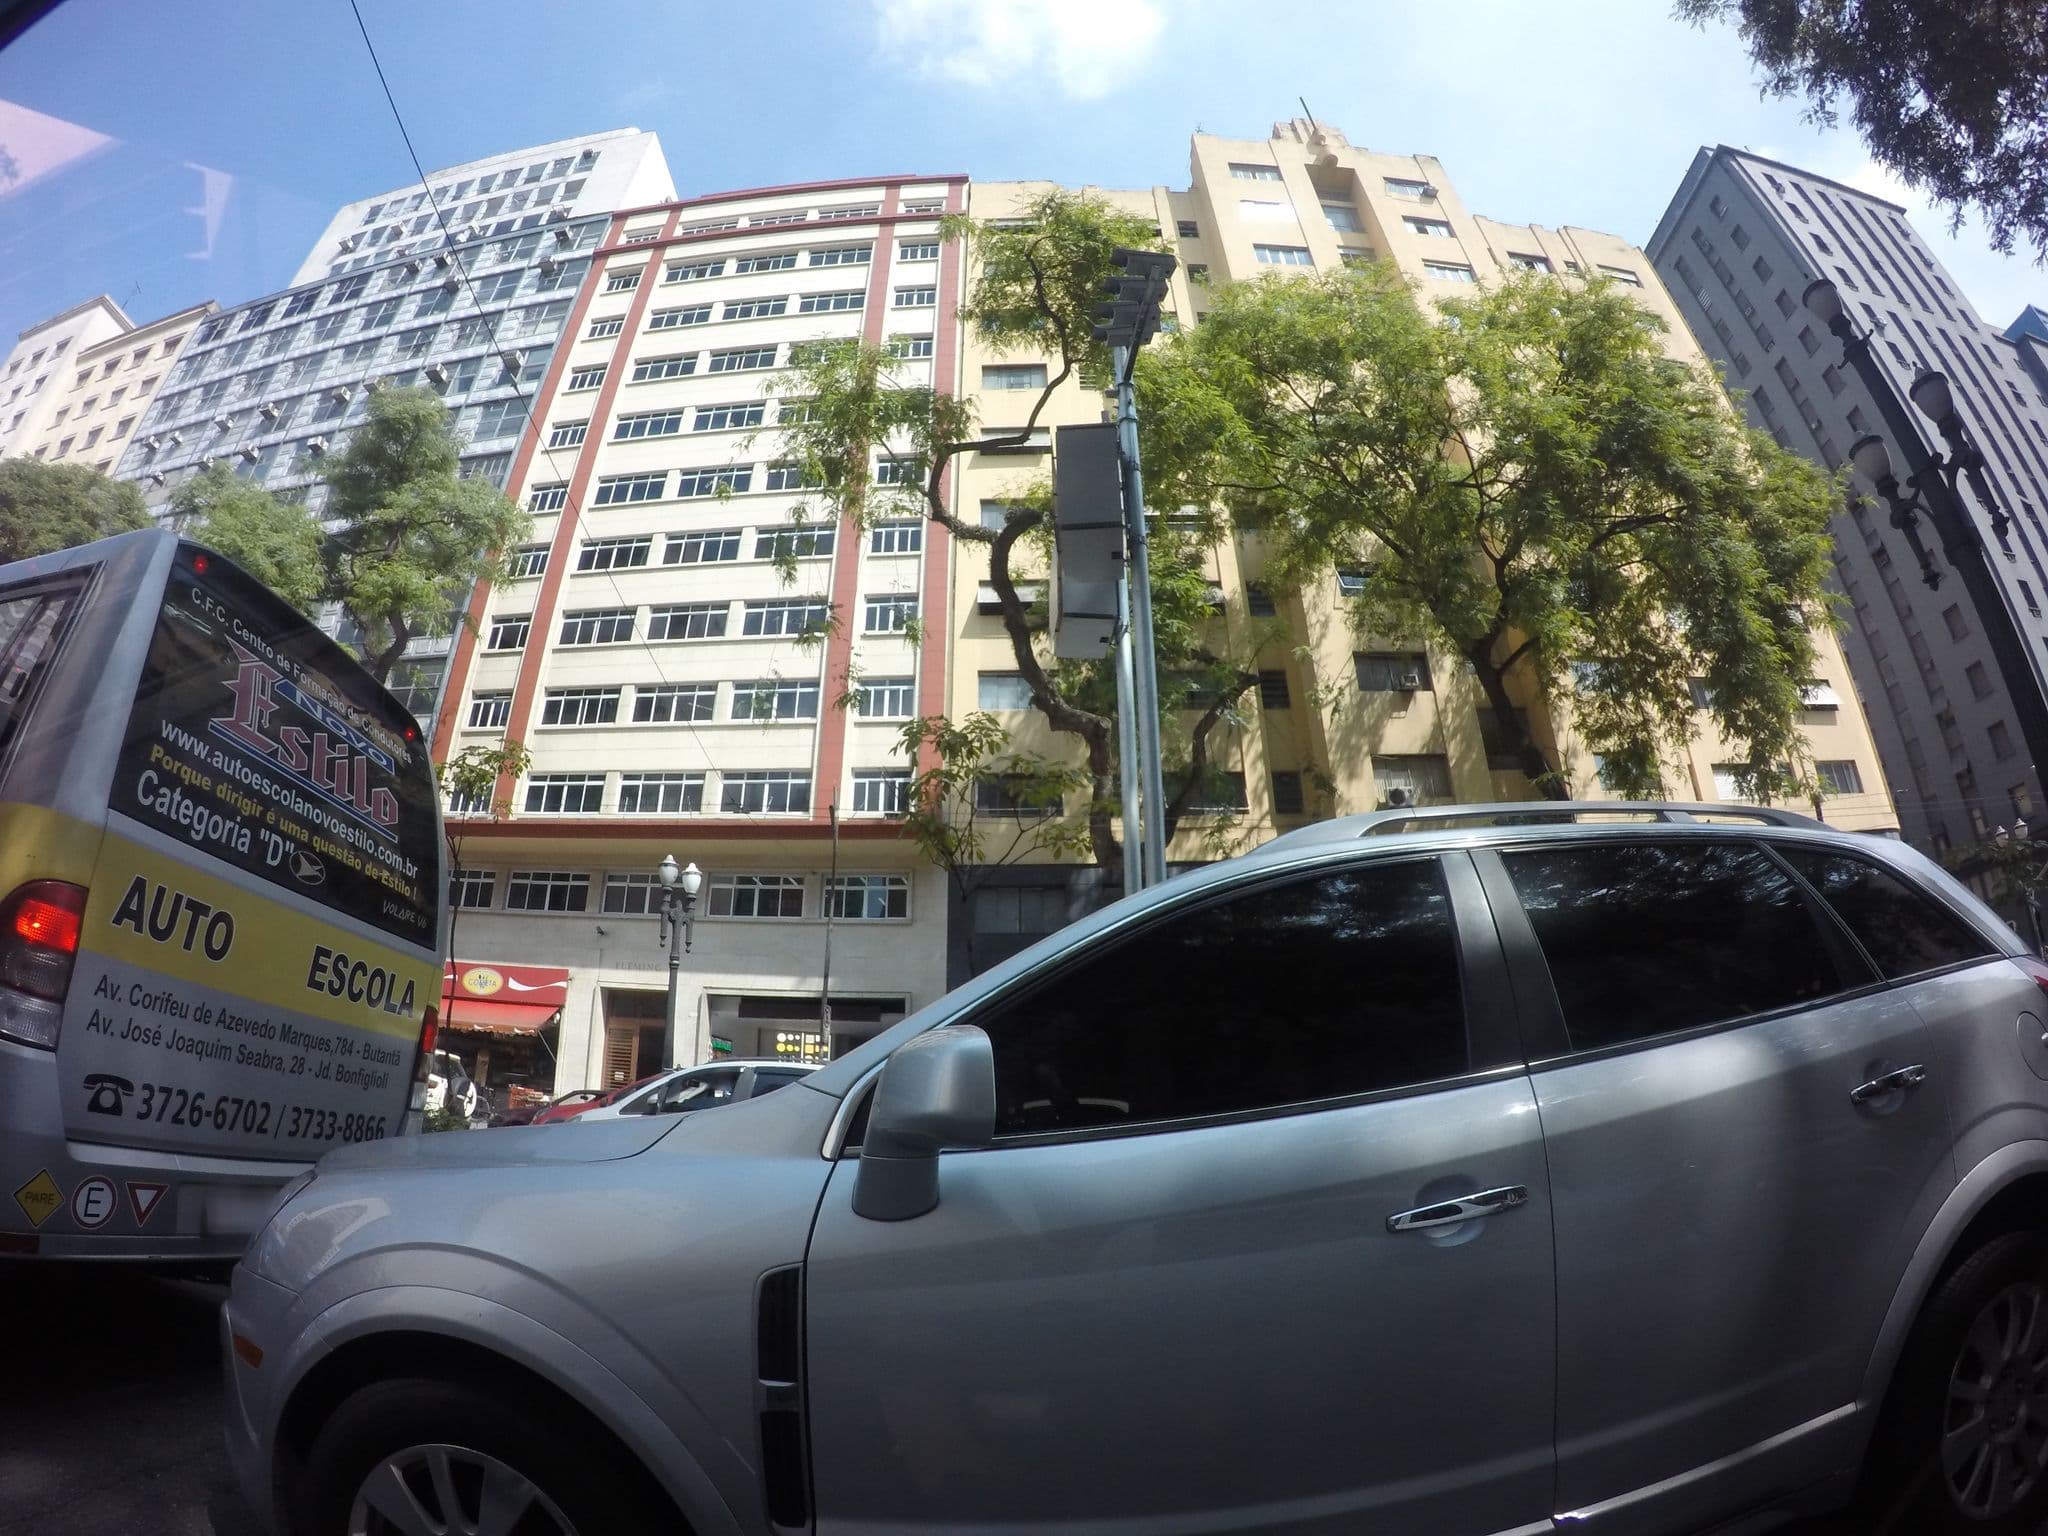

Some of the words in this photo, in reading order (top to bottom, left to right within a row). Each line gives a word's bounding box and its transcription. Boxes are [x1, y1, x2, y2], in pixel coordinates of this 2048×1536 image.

[192, 588, 229, 627] C.F.C.
[233, 619, 273, 659] Centro
[277, 654, 290, 672] de
[293, 663, 345, 714] Formação
[347, 705, 360, 724] de
[362, 718, 412, 764] Condutores
[209, 634, 398, 825] Estilo
[138, 769, 252, 854] Categoria
[260, 828, 295, 867] "D"
[150, 743, 211, 790] Porque
[216, 783, 264, 817] dirigir
[266, 808, 275, 825] é
[280, 818, 308, 843] uma
[313, 835, 362, 870] questão
[365, 862, 378, 880] de
[380, 870, 411, 897] Estilo
[161, 719, 418, 879] www.autoescolanovoestilo.com.br
[112, 875, 235, 962] AUTO
[94, 974, 122, 1002] Av.
[129, 984, 190, 1020] Corifeu
[193, 1002, 212, 1024] de
[215, 1008, 276, 1040] Azevedo
[362, 1043, 400, 1066] Butantã
[307, 945, 415, 1018] ESCOLA
[86, 1009, 114, 1037] Av.
[121, 1017, 162, 1047] José
[166, 1028, 232, 1062] Joaquim
[237, 1044, 286, 1074] Seabra,
[289, 1056, 305, 1075] 28
[315, 1060, 332, 1081] Jd.
[336, 1064, 389, 1090] Bonfiglioli
[136, 1083, 272, 1135] 3726-6702
[288, 1106, 387, 1142] 3733-8866
[25, 1191, 55, 1206] PARE
[84, 1187, 104, 1217] E
